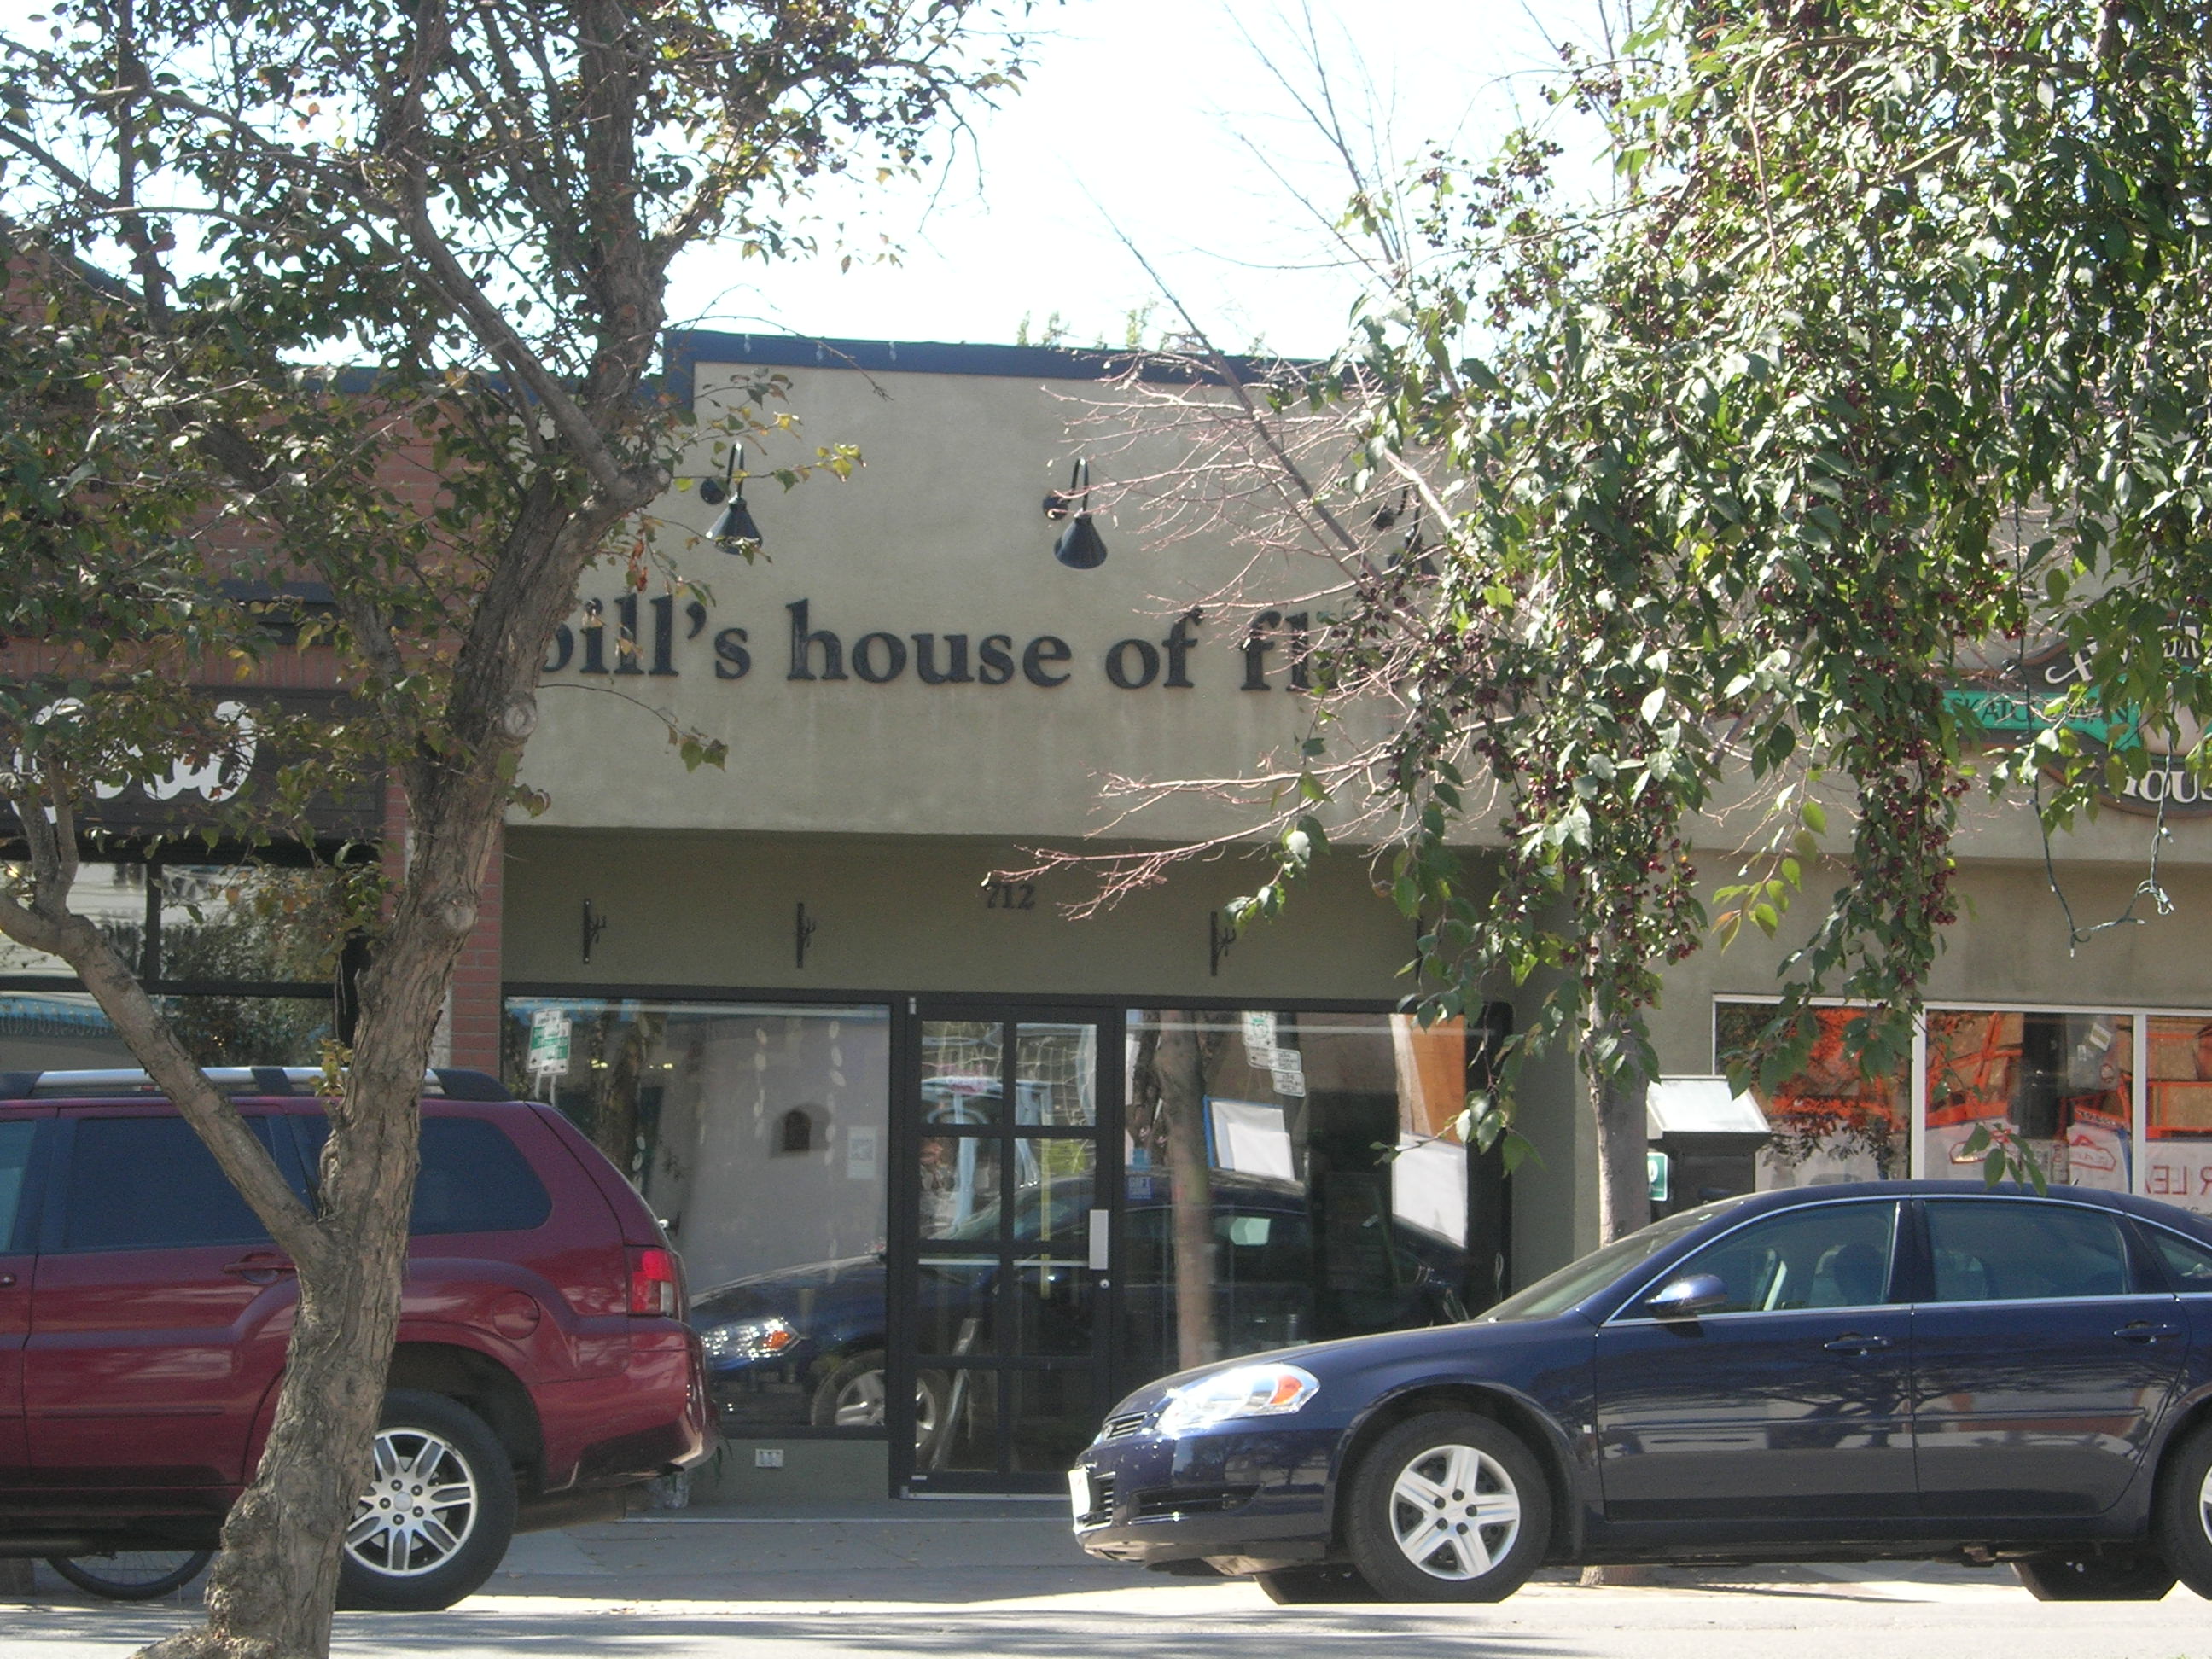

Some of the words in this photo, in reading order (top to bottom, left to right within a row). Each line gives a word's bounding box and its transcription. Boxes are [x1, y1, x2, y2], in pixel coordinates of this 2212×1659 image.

[785, 597, 1073, 686] house
[1105, 606, 1203, 690] of
[987, 882, 1036, 911] 712
